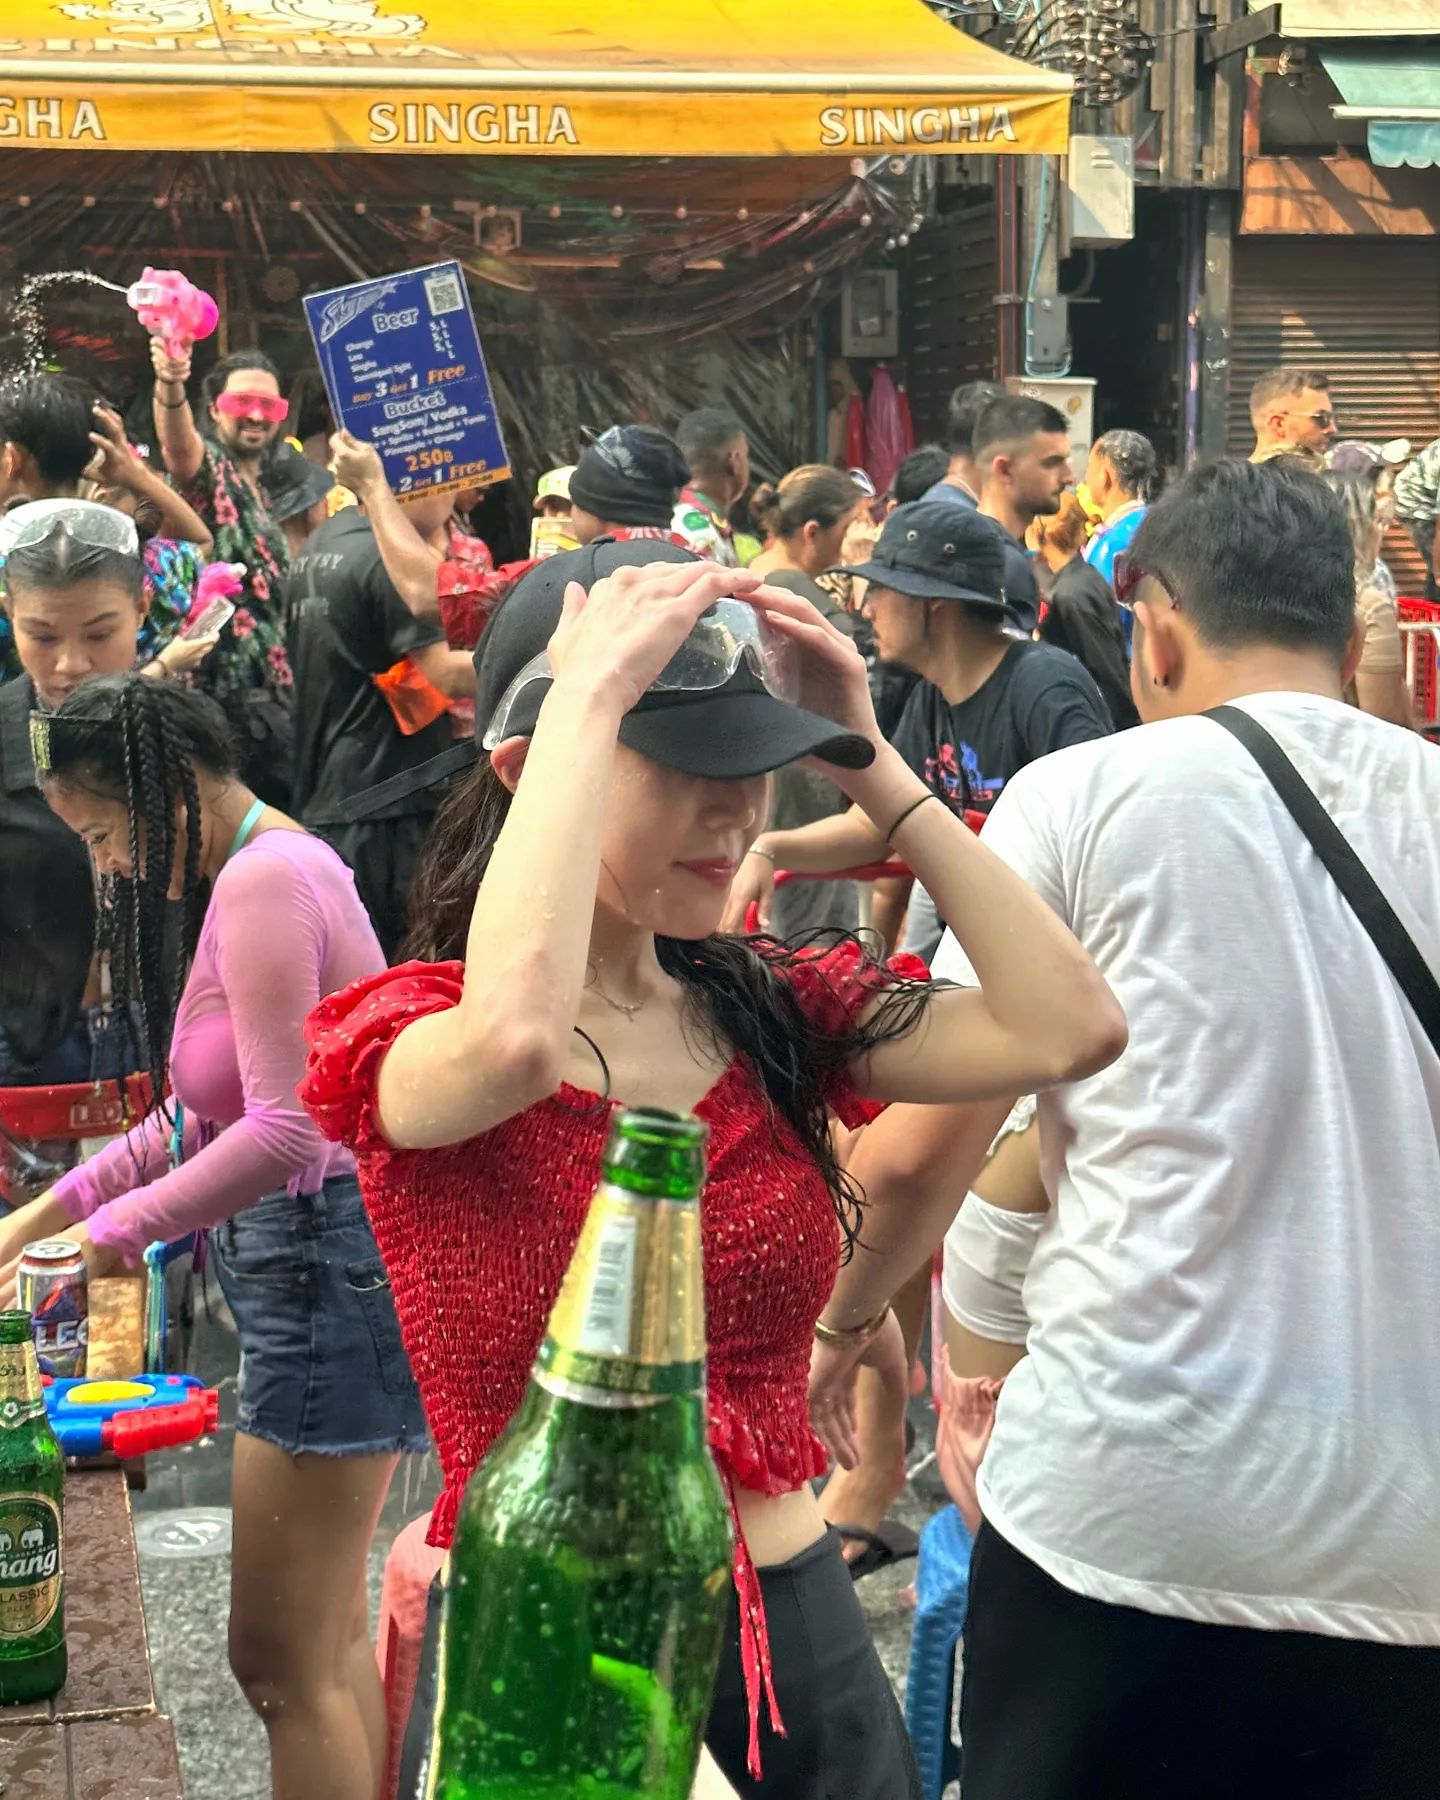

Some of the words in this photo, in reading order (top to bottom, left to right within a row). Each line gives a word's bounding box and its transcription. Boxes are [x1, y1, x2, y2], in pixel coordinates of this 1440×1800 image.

[368, 103, 579, 145] SINGHA
[820, 106, 1018, 147] SINGHA
[372, 307, 418, 332] Beer
[375, 381, 387, 397] 3
[409, 373, 418, 389] 1
[427, 365, 464, 384] Free
[383, 391, 445, 419] Bucket
[399, 476, 414, 493] 2
[434, 468, 442, 484] 1
[449, 459, 486, 479] Free
